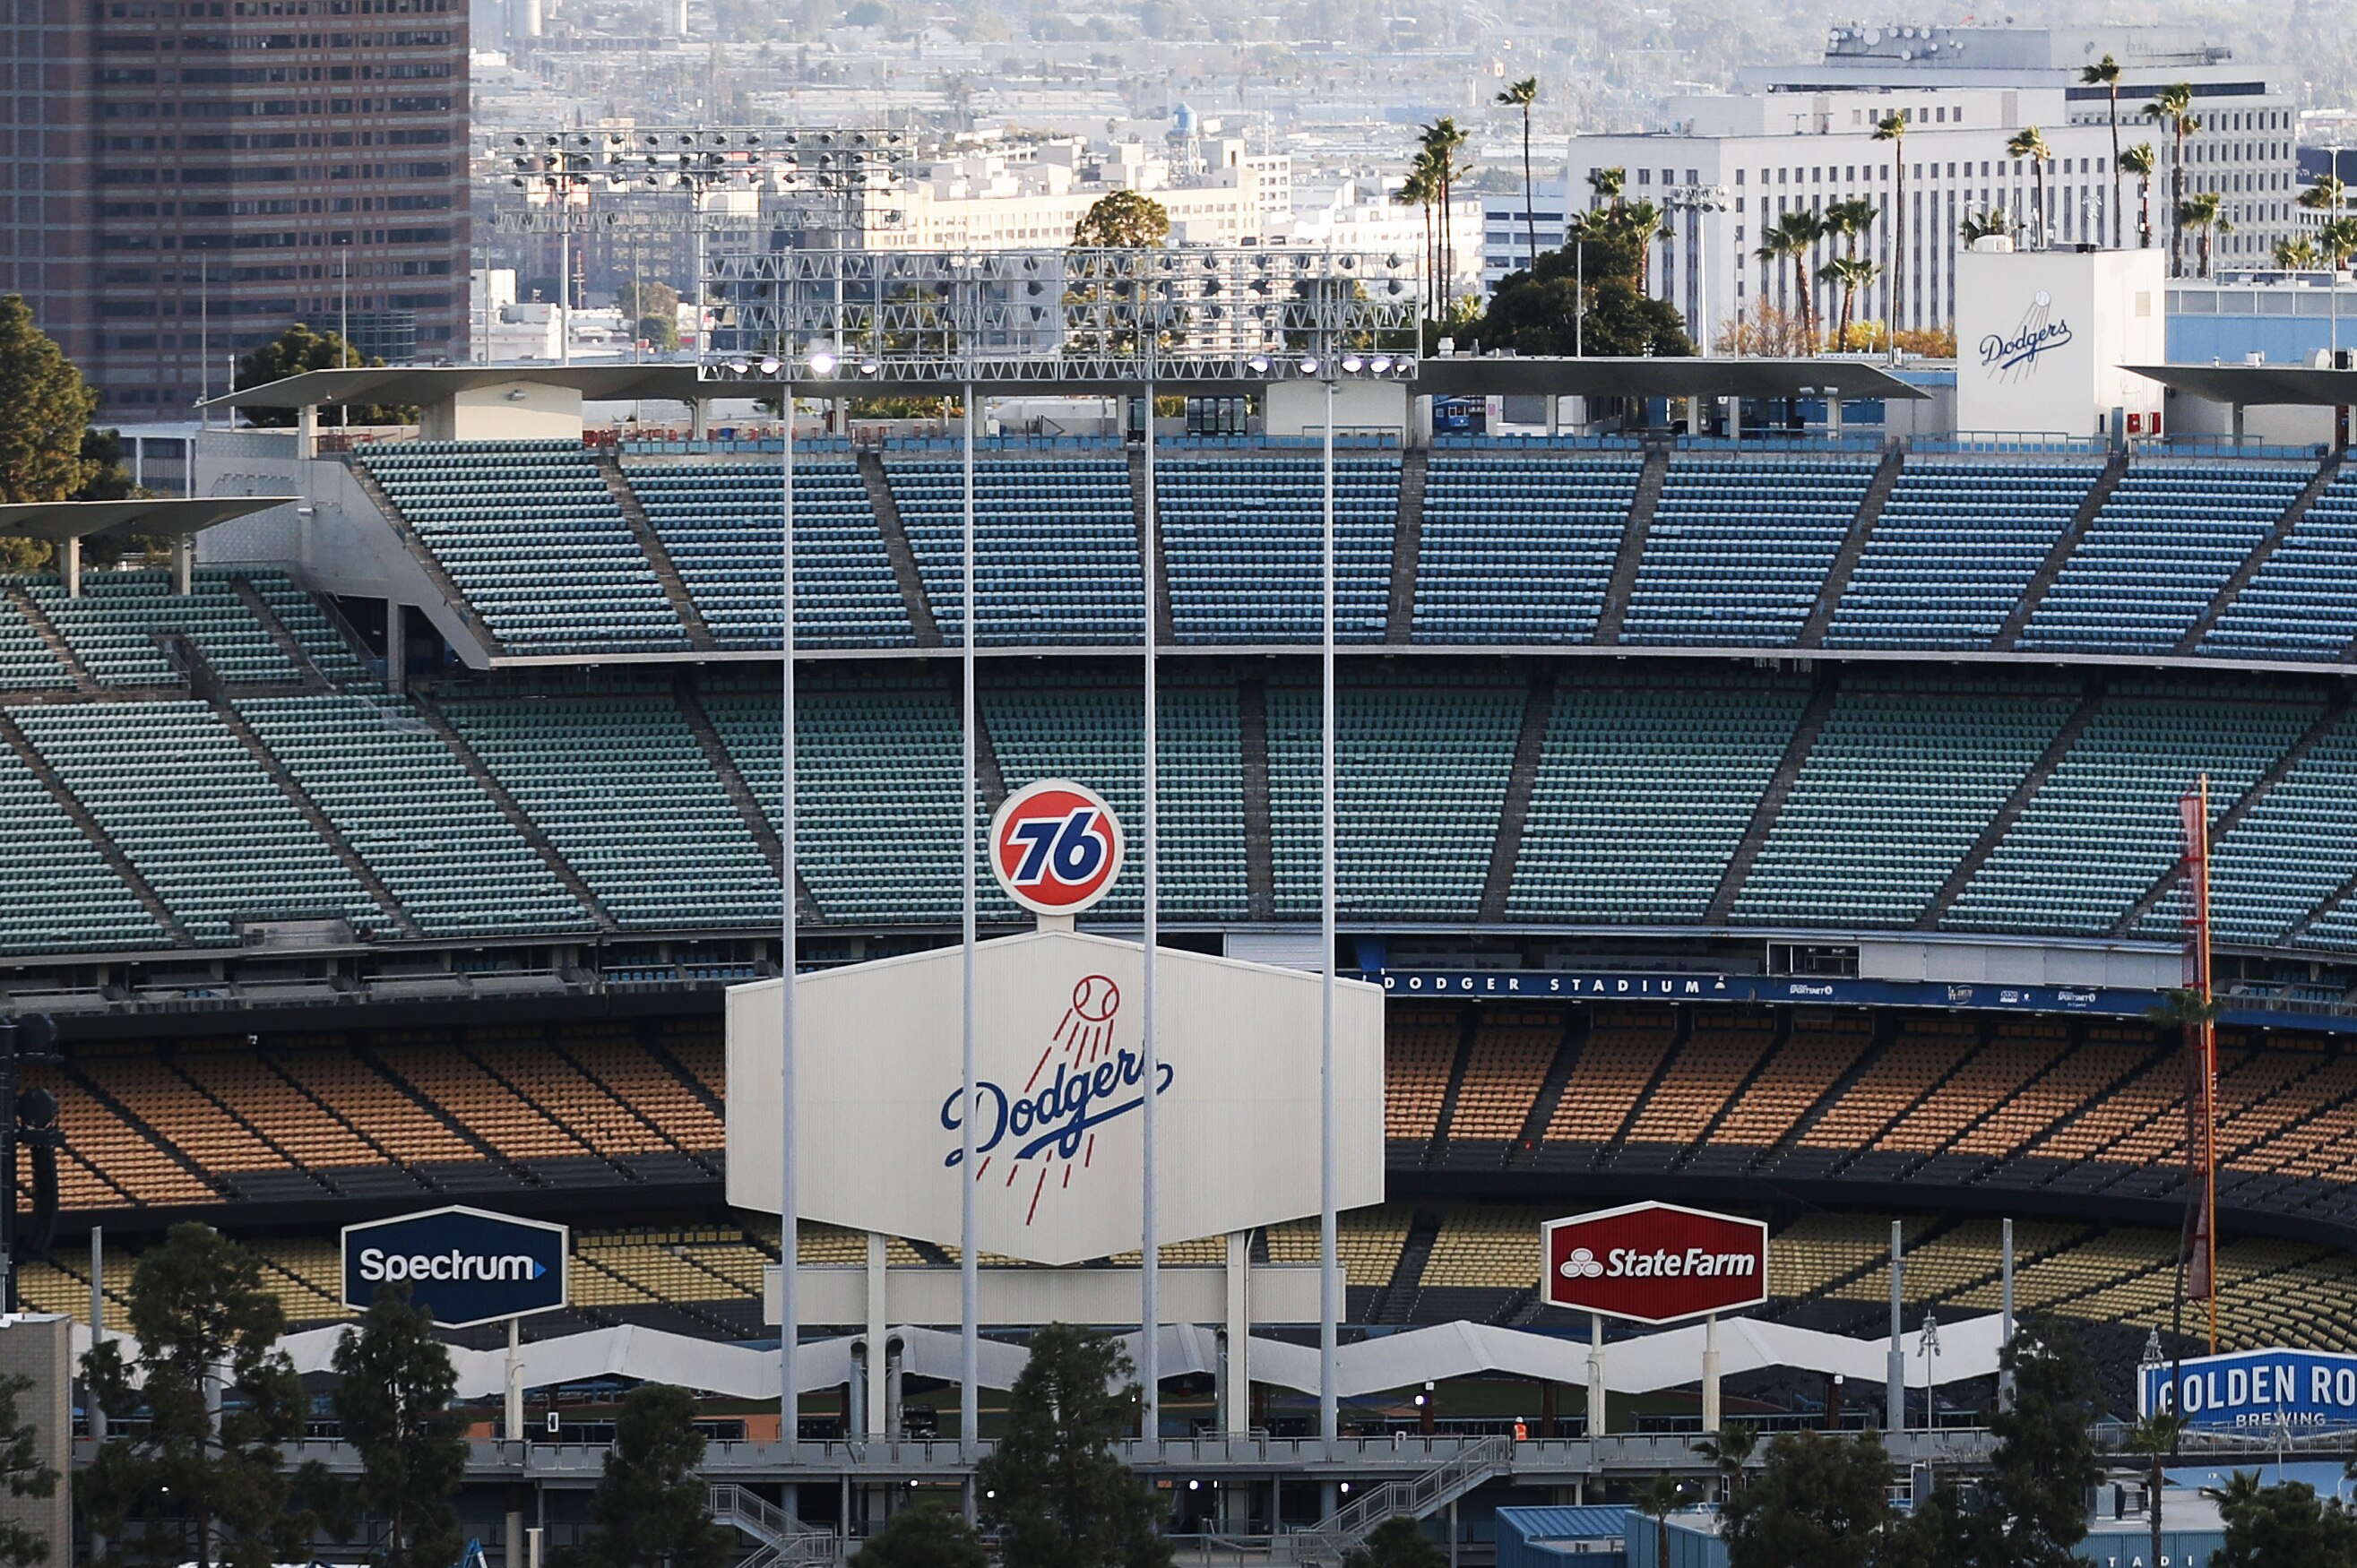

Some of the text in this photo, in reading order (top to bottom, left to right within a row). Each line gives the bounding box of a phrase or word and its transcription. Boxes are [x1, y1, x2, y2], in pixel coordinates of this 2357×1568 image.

[1979, 319, 2072, 369] Dodgers
[1007, 807, 1107, 885] 76
[1384, 977, 1700, 994] DODGER STADIUM
[359, 1248, 534, 1282] Spectrum
[2311, 1366, 2355, 1407] RO
[2236, 1412, 2326, 1427] BREWING
[2108, 1555, 2193, 1567] TADI
